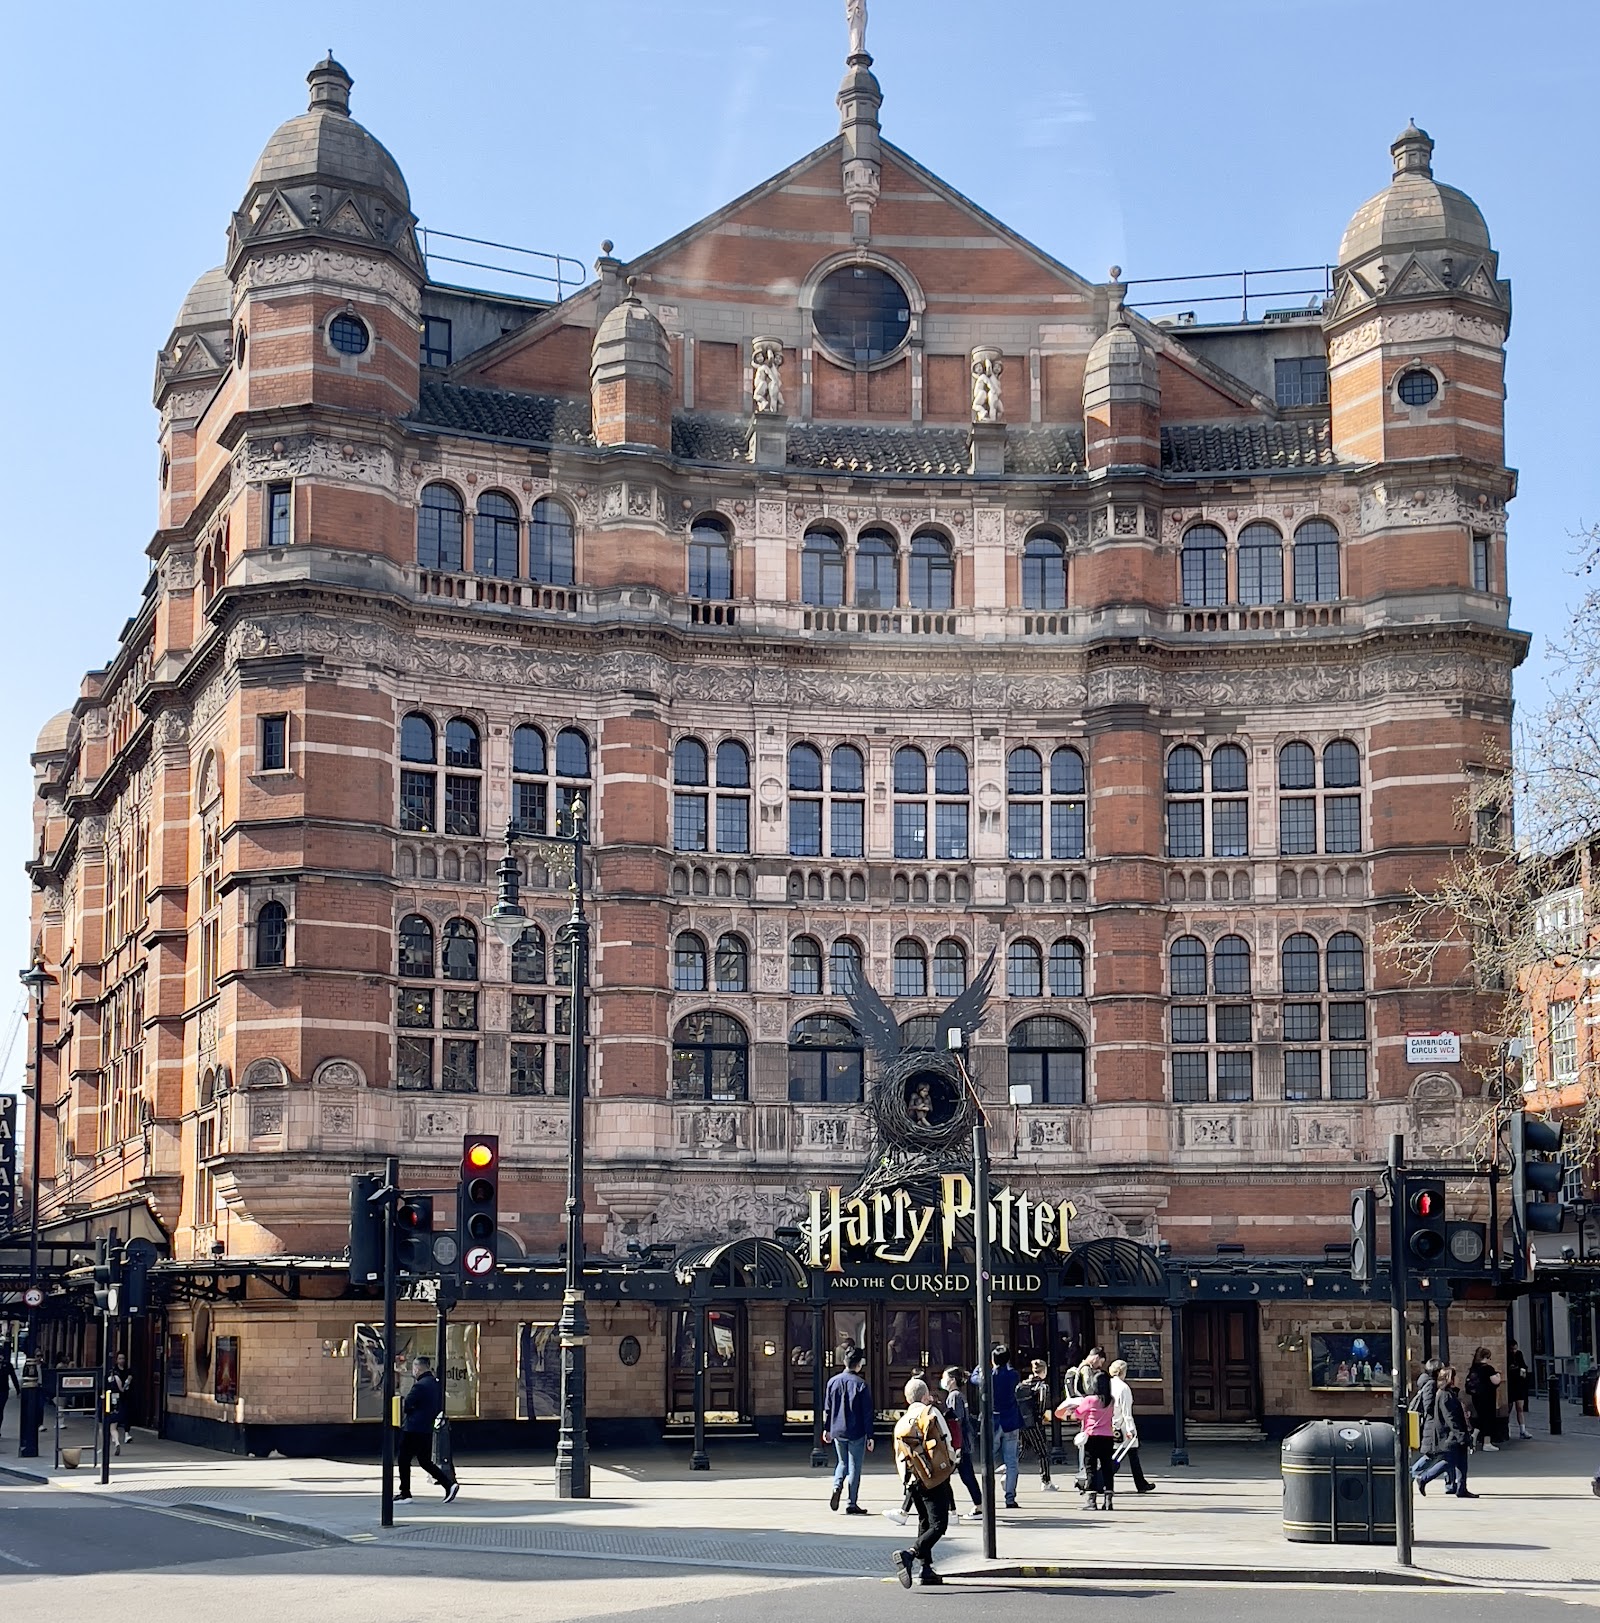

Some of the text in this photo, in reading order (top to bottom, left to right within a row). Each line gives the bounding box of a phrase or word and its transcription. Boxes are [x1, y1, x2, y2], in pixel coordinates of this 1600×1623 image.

[799, 1185, 935, 1273] Harry
[831, 1274, 1042, 1293] AND THE CURSED HILD
[446, 1366, 468, 1380] otter
